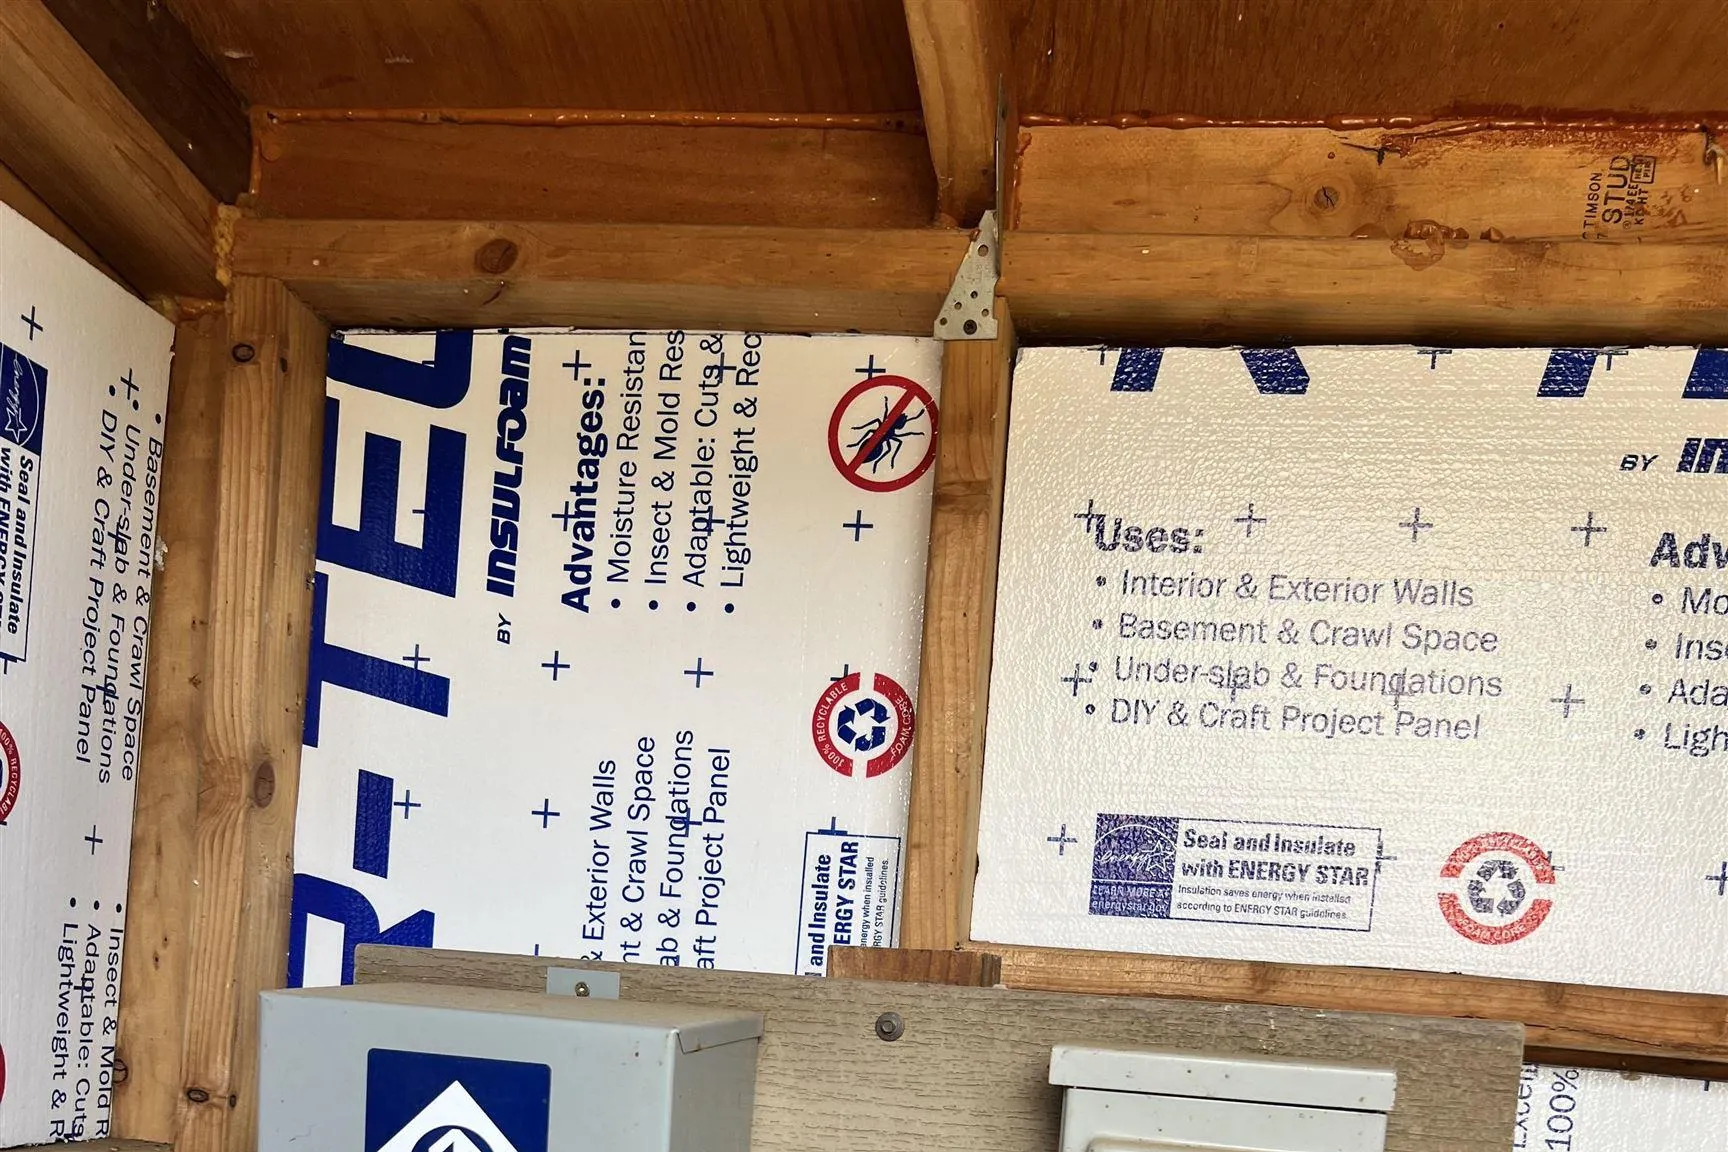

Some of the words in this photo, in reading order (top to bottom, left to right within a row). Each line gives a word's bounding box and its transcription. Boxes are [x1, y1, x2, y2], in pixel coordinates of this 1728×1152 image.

[1583, 172, 1602, 229] TIMSON
[1602, 155, 1631, 224] STUD
[660, 330, 685, 381] Res
[700, 334, 723, 353] &
[736, 333, 762, 386] Rec
[617, 332, 647, 450] Resistan
[694, 365, 719, 427] Cuts
[734, 396, 757, 417] &
[100, 409, 118, 463] DIY
[654, 393, 680, 460] Mold
[17, 455, 33, 504] Seal
[97, 466, 113, 488] &
[652, 470, 675, 492] &
[1619, 453, 1659, 472] BY
[114, 424, 141, 574] Under-slab
[138, 437, 163, 578] Basement
[561, 378, 608, 613] Advantages:
[607, 461, 637, 582] Moisture
[683, 438, 715, 587] Adaptable:
[721, 427, 758, 587] Lightweight
[15, 508, 27, 551] and
[90, 499, 110, 570] Craft
[645, 500, 672, 583] Insect
[1095, 517, 1204, 553] Uses:
[8, 553, 27, 634] Insulate
[113, 583, 127, 604] &
[136, 586, 150, 606] &
[1122, 569, 1227, 598] Interior
[1235, 573, 1258, 599] &
[1269, 574, 1384, 604] Exterior
[1394, 578, 1474, 607] Walls
[82, 577, 105, 676] Project
[130, 615, 148, 689] Crawl
[497, 612, 511, 645] BY
[1119, 613, 1267, 643] Basement
[1277, 618, 1299, 644] &
[1310, 619, 1392, 648] Crawl
[1402, 622, 1498, 655] Space
[99, 613, 125, 784] Foundations
[1115, 656, 1270, 688] Under-slab
[1281, 662, 1302, 688] &
[1315, 663, 1502, 697] Foundations
[76, 684, 96, 763] Panel
[122, 700, 142, 781] Space
[816, 682, 848, 742] RECYCLABLE
[1111, 698, 1160, 725] DIY
[1167, 700, 1188, 727] &
[1200, 701, 1271, 731] Craft
[1282, 705, 1385, 739] Project
[1395, 711, 1481, 739] Panel
[628, 736, 655, 822] Space
[703, 748, 731, 823] Panel
[822, 744, 845, 767] 100%
[589, 759, 616, 831] Walls
[660, 729, 693, 898] Foundations
[622, 831, 648, 903] Crawl
[838, 841, 859, 890] STAR
[1182, 858, 1223, 878] with
[1228, 860, 1311, 883] ENERGY
[1315, 864, 1368, 886] STAR
[1184, 828, 1228, 850] Seal
[1233, 833, 1271, 852] and
[1274, 833, 1356, 857] Insulate
[582, 839, 610, 940] Exterior
[695, 832, 726, 927] Project
[808, 855, 831, 929] Insulate
[1177, 901, 1220, 913] according
[1223, 904, 1232, 912] to
[1234, 903, 1272, 915] ENERGY
[1273, 905, 1298, 916] STAR
[1178, 885, 1221, 896] Insulation
[1224, 888, 1250, 898] saves
[1252, 890, 1283, 901] energy
[620, 912, 642, 933] &
[658, 908, 680, 928] &
[104, 928, 123, 1007] Insect
[808, 932, 826, 966] and
[52, 923, 78, 1080] Lightweight
[78, 923, 101, 1068] Adaptable:
[102, 1016, 117, 1035] &
[51, 1088, 67, 1109] &
[97, 1046, 115, 1108] Mold
[1545, 1069, 1580, 1151] 100%
